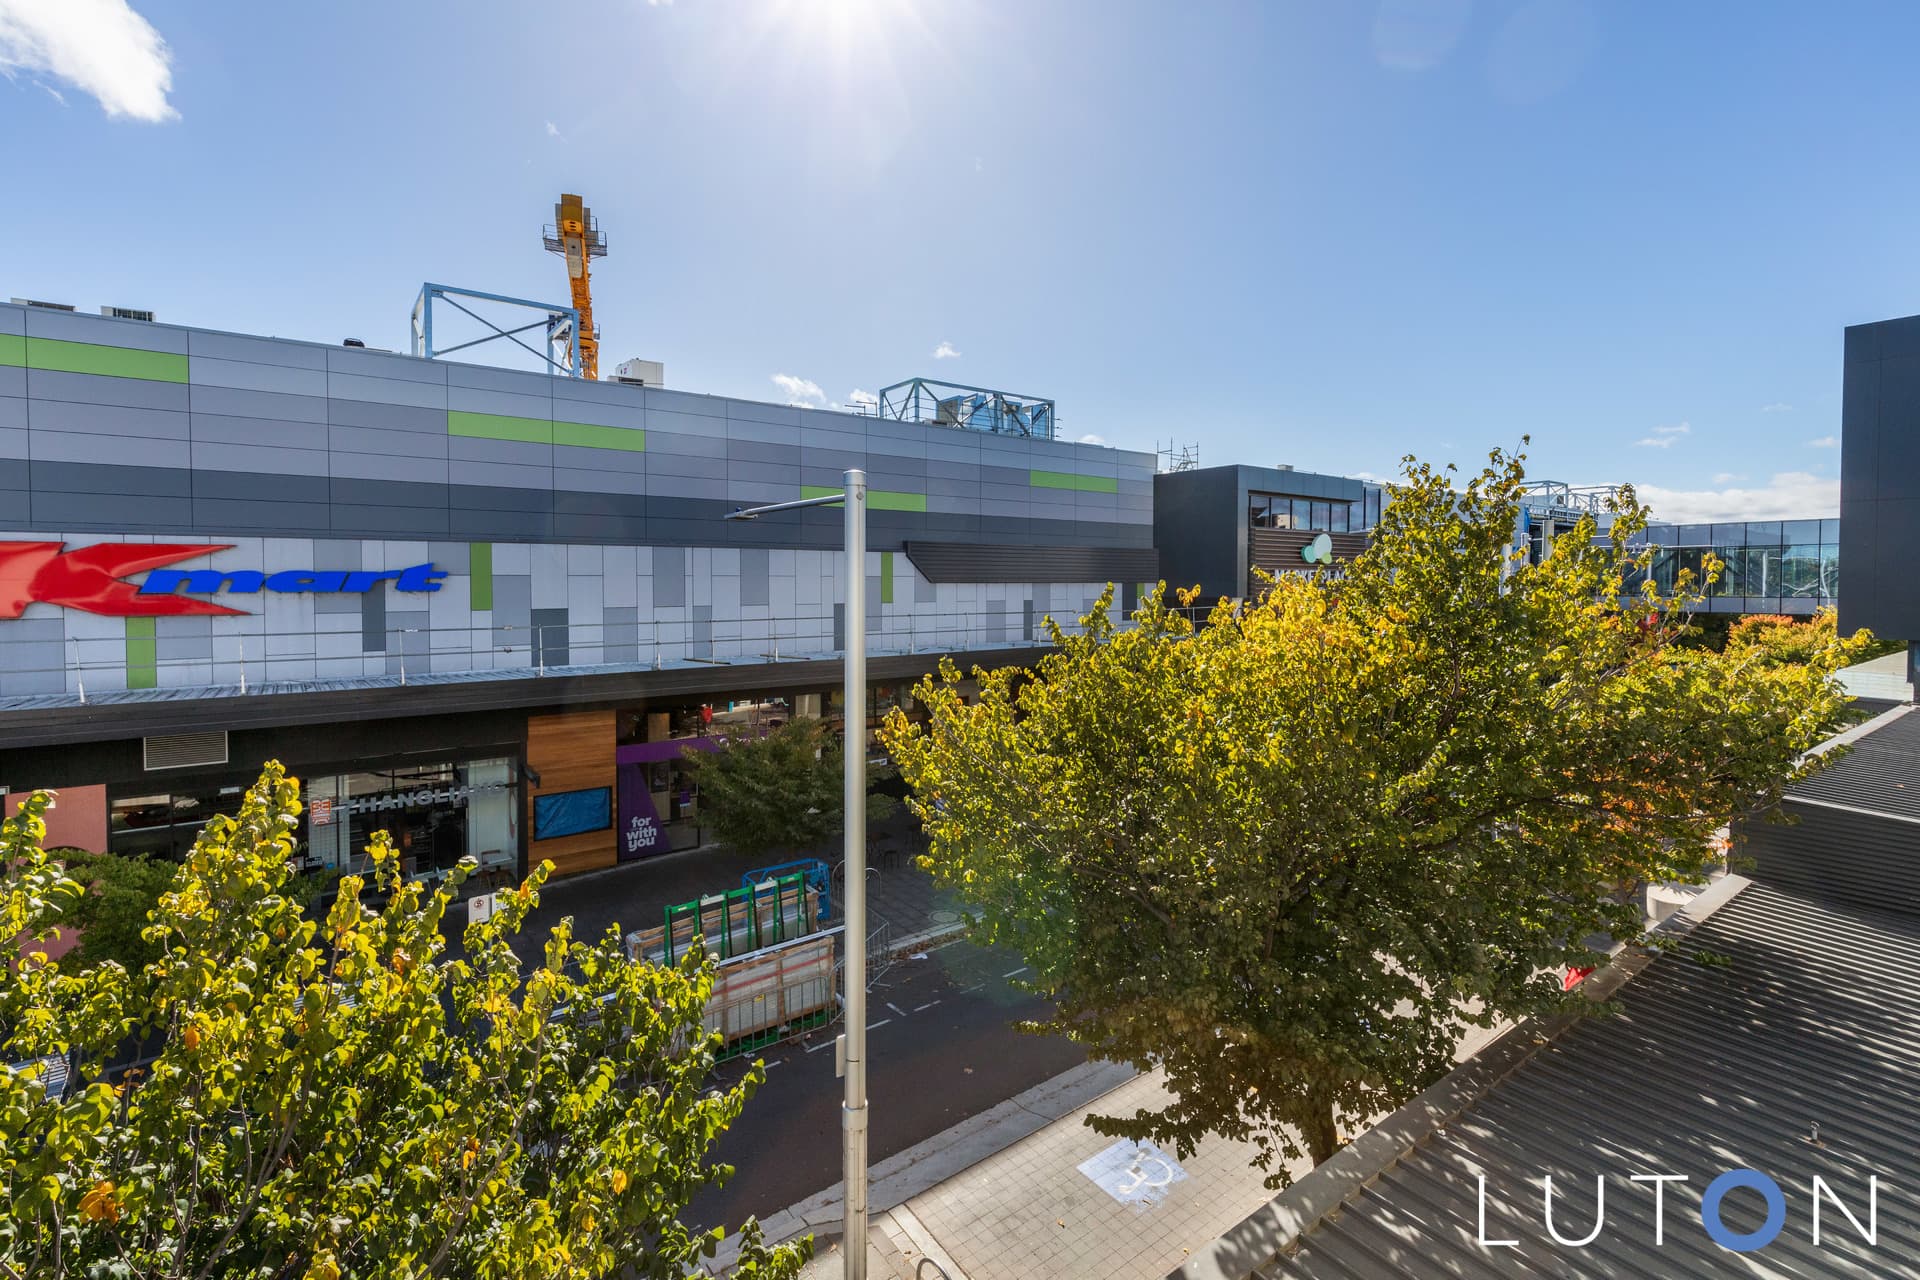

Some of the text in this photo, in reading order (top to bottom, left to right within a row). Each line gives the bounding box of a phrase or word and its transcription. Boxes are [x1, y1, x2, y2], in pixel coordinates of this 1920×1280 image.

[0, 542, 449, 618] Kmart
[632, 816, 652, 828] for
[626, 825, 657, 841] with
[628, 836, 655, 852] you
